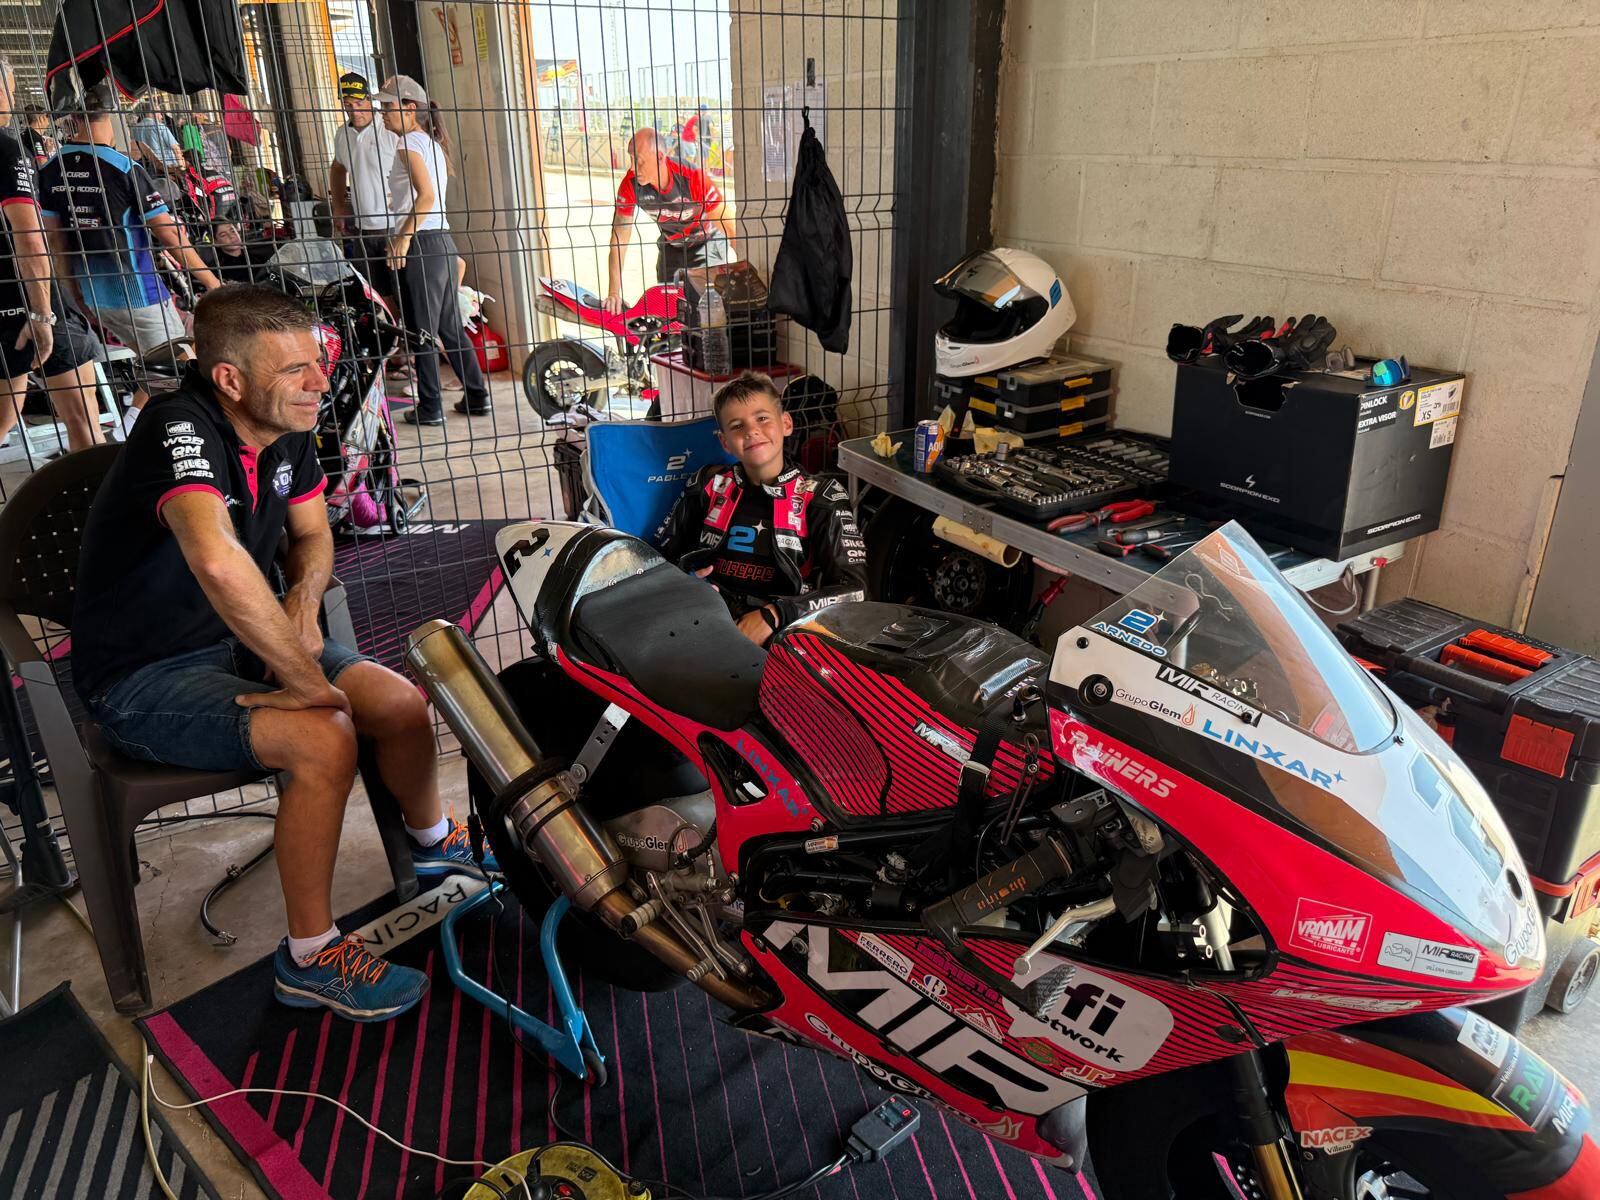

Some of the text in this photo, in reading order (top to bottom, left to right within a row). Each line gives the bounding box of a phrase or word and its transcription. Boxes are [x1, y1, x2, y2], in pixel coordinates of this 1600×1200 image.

[1360, 396, 1387, 411] PINLOCK
[1422, 410, 1431, 422] XS
[1358, 411, 1396, 429] EXTRA VISOR
[667, 456, 686, 470] 2
[1220, 483, 1262, 497] SCORPION
[727, 525, 757, 554] 2
[1367, 520, 1406, 534] SCORPION
[503, 528, 550, 578] 2
[1118, 608, 1158, 634] 2
[1094, 621, 1168, 658] ARNEDO
[1115, 687, 1182, 722] GrupoGlem
[1158, 664, 1256, 718] MIR RACING
[1202, 718, 1333, 790] LINXAR
[736, 739, 799, 817] LINXAR
[859, 936, 909, 975] FERRERO
[1313, 941, 1356, 957] LUBRICANTS
[1422, 944, 1475, 962] MIR RACING
[762, 918, 1090, 1116] MIR
[1060, 983, 1126, 1037] fi
[1033, 1012, 1126, 1064] etwork
[1302, 1127, 1372, 1147] NACEX
